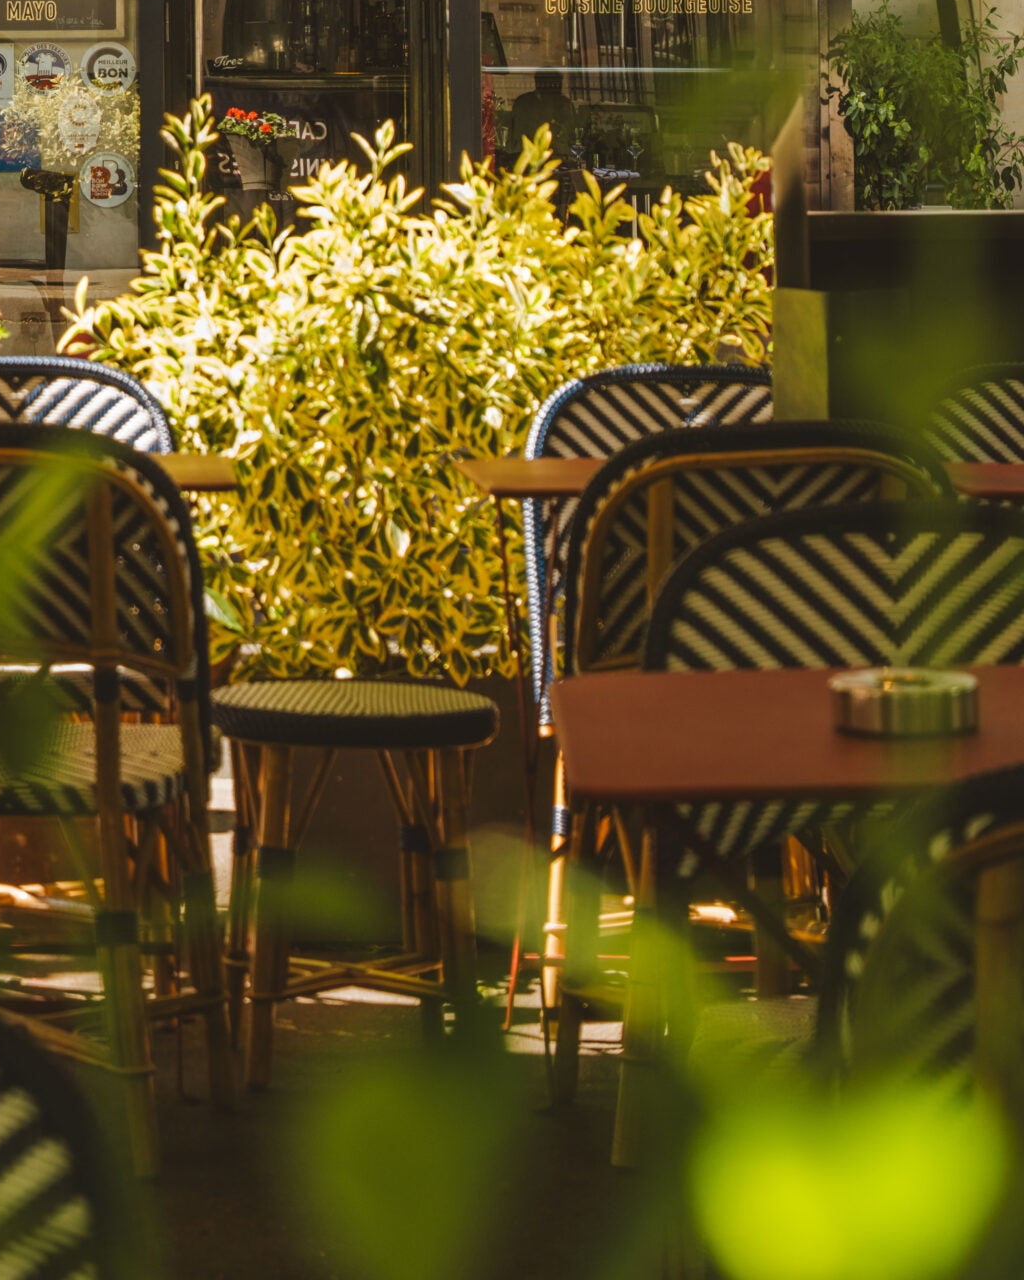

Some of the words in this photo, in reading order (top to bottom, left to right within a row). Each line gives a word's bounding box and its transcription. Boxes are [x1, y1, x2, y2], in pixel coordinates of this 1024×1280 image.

[6, 0, 58, 21] MAYO
[213, 54, 244, 68] Tirez
[97, 67, 129, 79] BON
